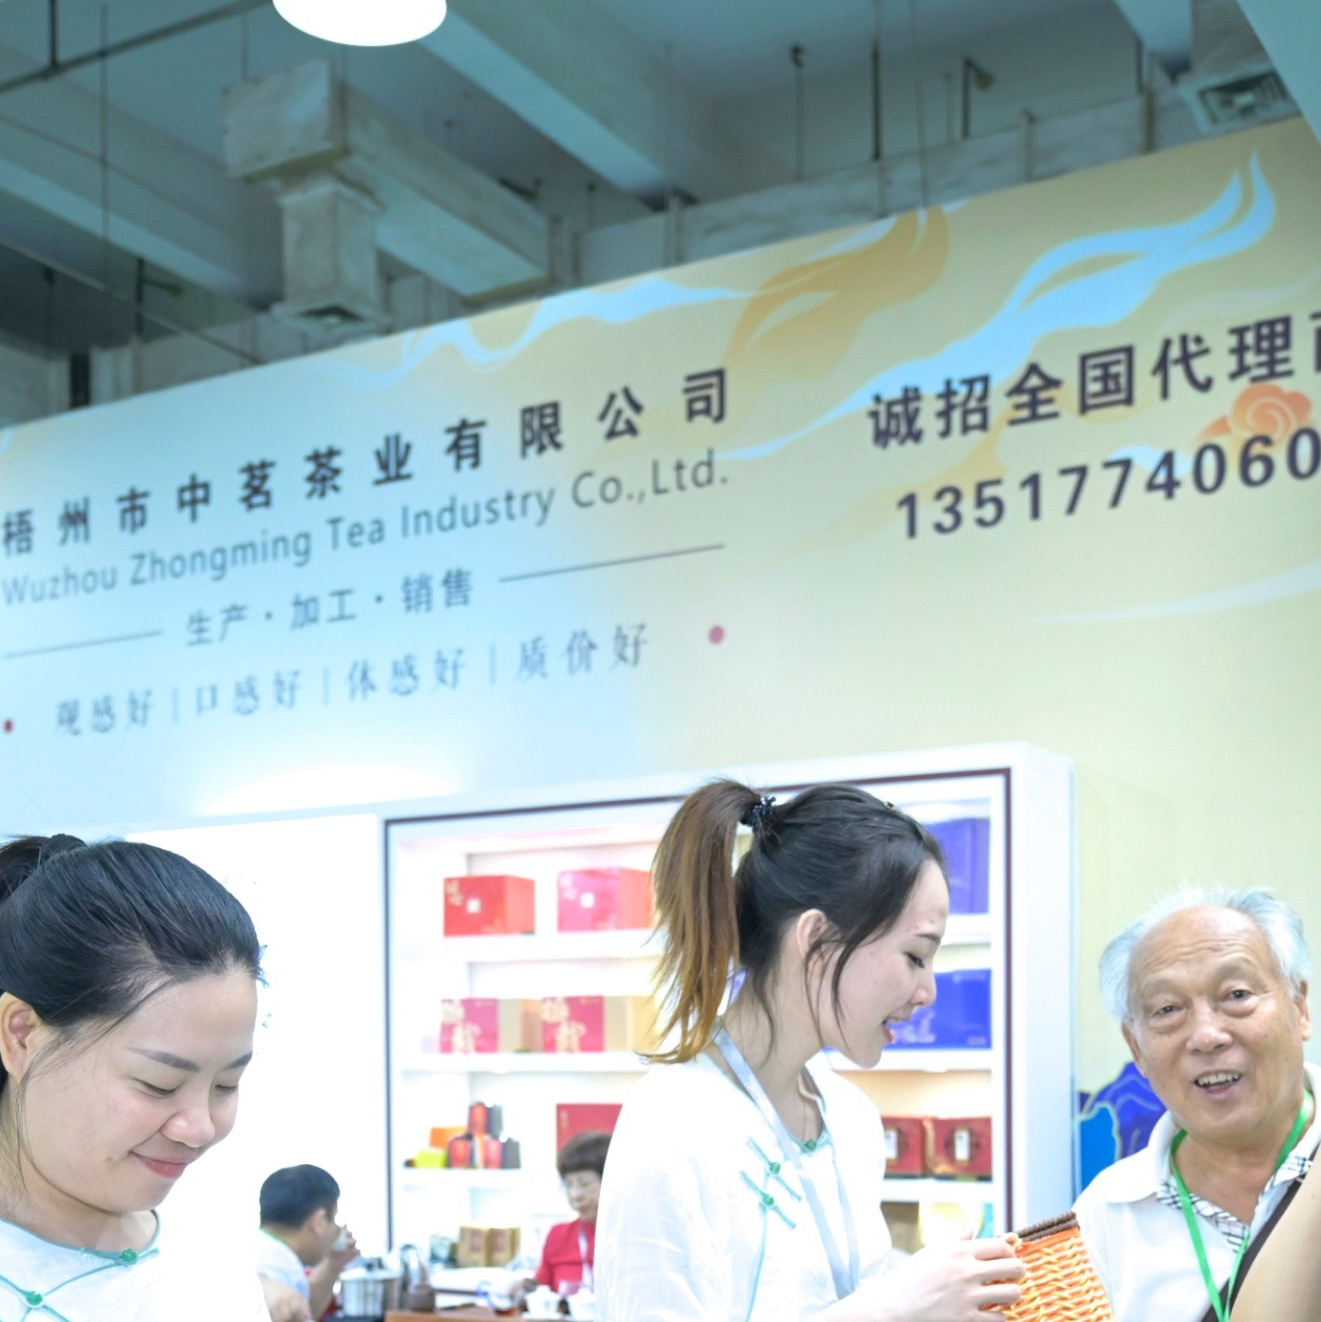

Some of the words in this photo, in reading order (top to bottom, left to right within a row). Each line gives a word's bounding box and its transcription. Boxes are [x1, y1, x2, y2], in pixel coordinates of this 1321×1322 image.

[2, 368, 726, 557] 梧州市中茗茶业有限公司
[1, 564, 118, 607] Wuzhou
[130, 528, 311, 583] Zhongming
[327, 515, 386, 551] Tea
[400, 486, 556, 539] Industry
